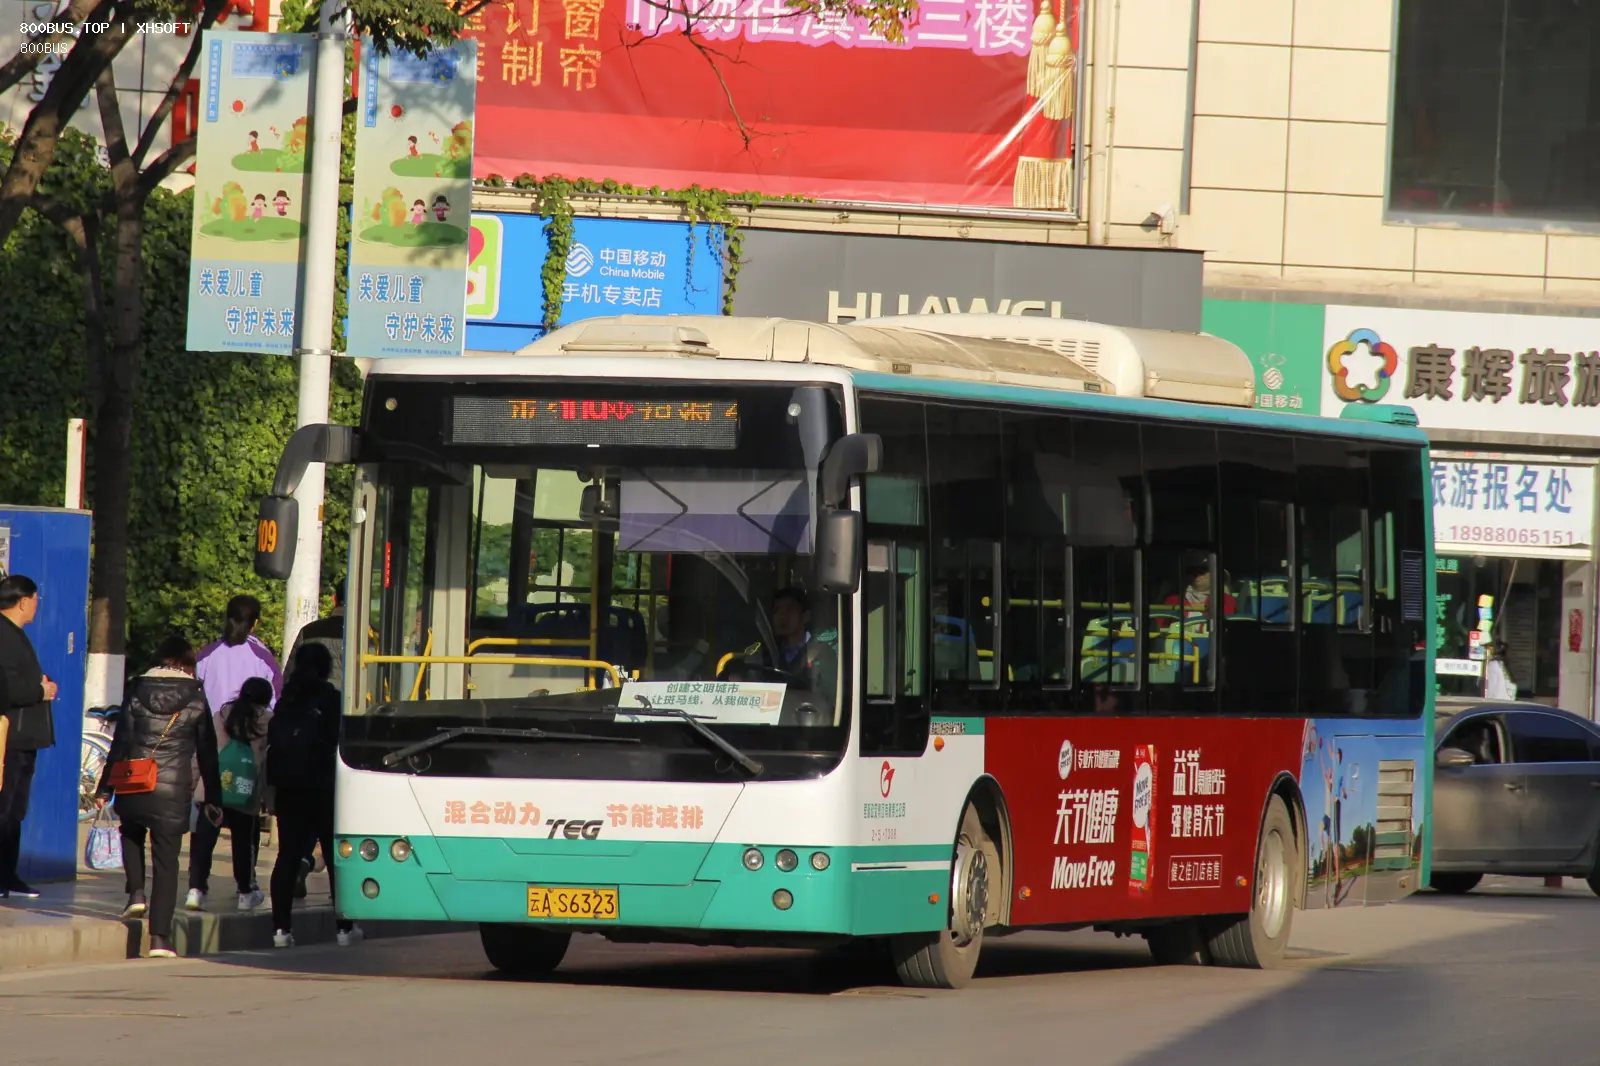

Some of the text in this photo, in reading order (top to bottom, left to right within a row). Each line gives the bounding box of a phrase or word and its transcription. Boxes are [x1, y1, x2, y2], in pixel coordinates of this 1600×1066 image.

[600, 248, 666, 267] 中国移动
[199, 267, 263, 297] 关爱儿童
[600, 266, 665, 280] China Mobile
[358, 272, 423, 304] 关爱儿童
[561, 282, 663, 308] 手机专卖店
[225, 305, 295, 337] 守护未来
[385, 312, 454, 343] 守护未来
[1255, 393, 1303, 409] 国移动
[667, 682, 740, 693] 创建文明城市
[642, 695, 761, 707] 让斑马线，从我做起
[444, 800, 541, 825] 混合动力
[606, 804, 704, 829] 节能减排
[1053, 788, 1120, 845] 关节健康
[545, 819, 604, 840] TEG
[1051, 856, 1086, 890] Move
[1086, 856, 1116, 888] Free
